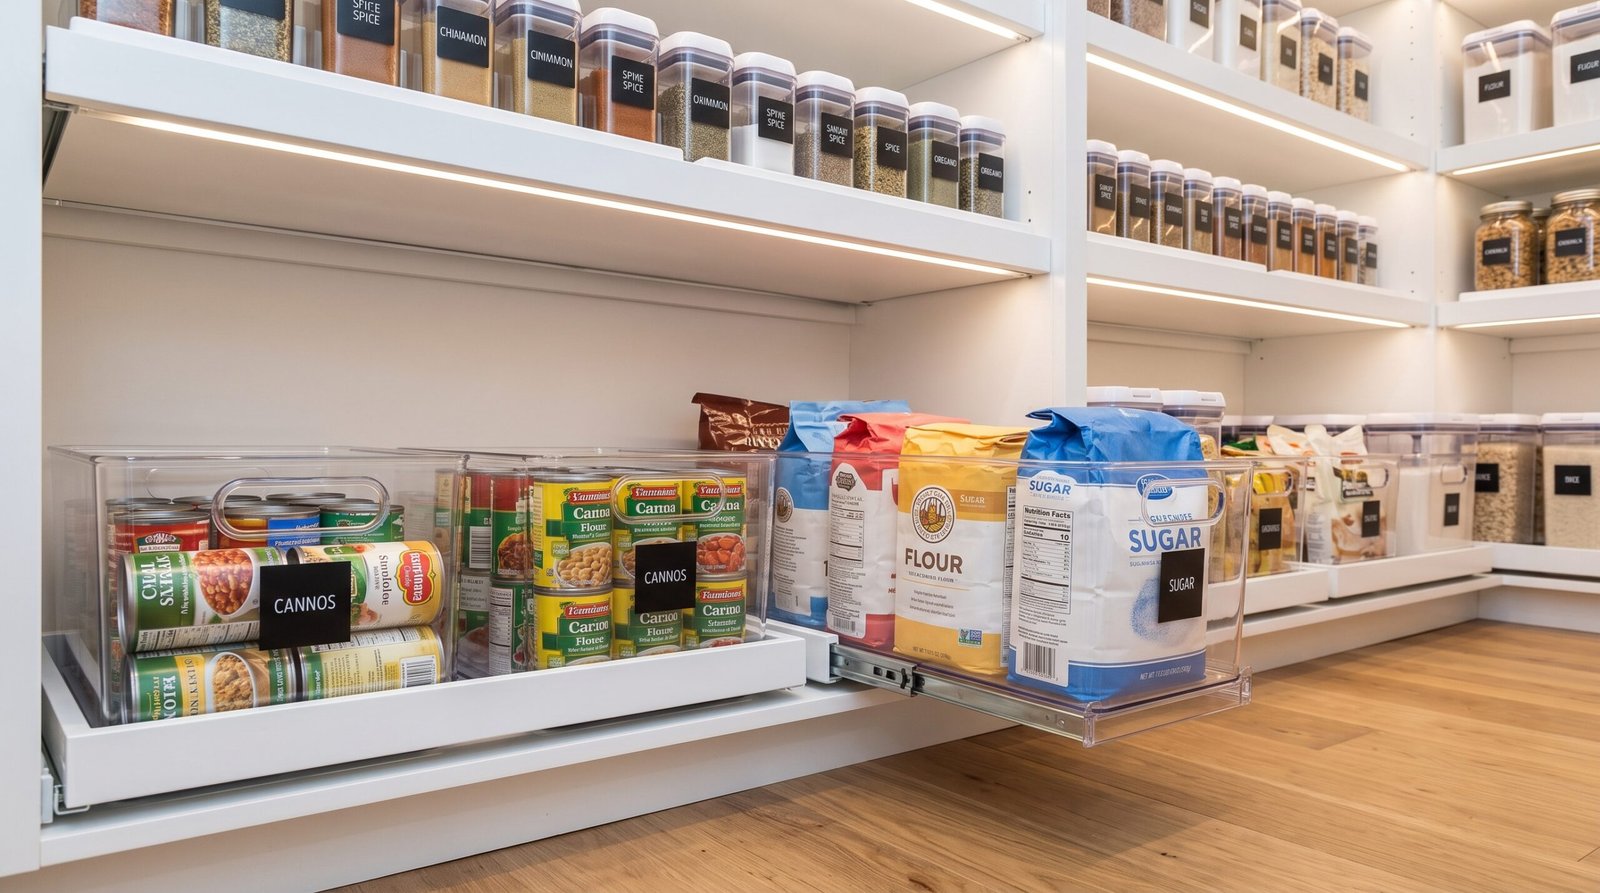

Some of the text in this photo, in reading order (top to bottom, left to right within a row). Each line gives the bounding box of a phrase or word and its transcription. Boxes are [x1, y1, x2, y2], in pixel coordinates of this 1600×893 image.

[353, 10, 380, 26] SPICE
[623, 82, 644, 94] SPICE
[767, 118, 785, 130] SPICE
[829, 134, 845, 145] SPICE
[885, 143, 900, 154] SPICE
[1029, 480, 1071, 495] SUGAR
[1024, 507, 1071, 519] Nutrition Facts
[1128, 527, 1202, 553] SUGAR
[905, 548, 963, 574] FLOUR
[644, 568, 687, 585] CANNOS
[1169, 576, 1195, 593] SUGAR
[274, 594, 336, 614] CANNOS
